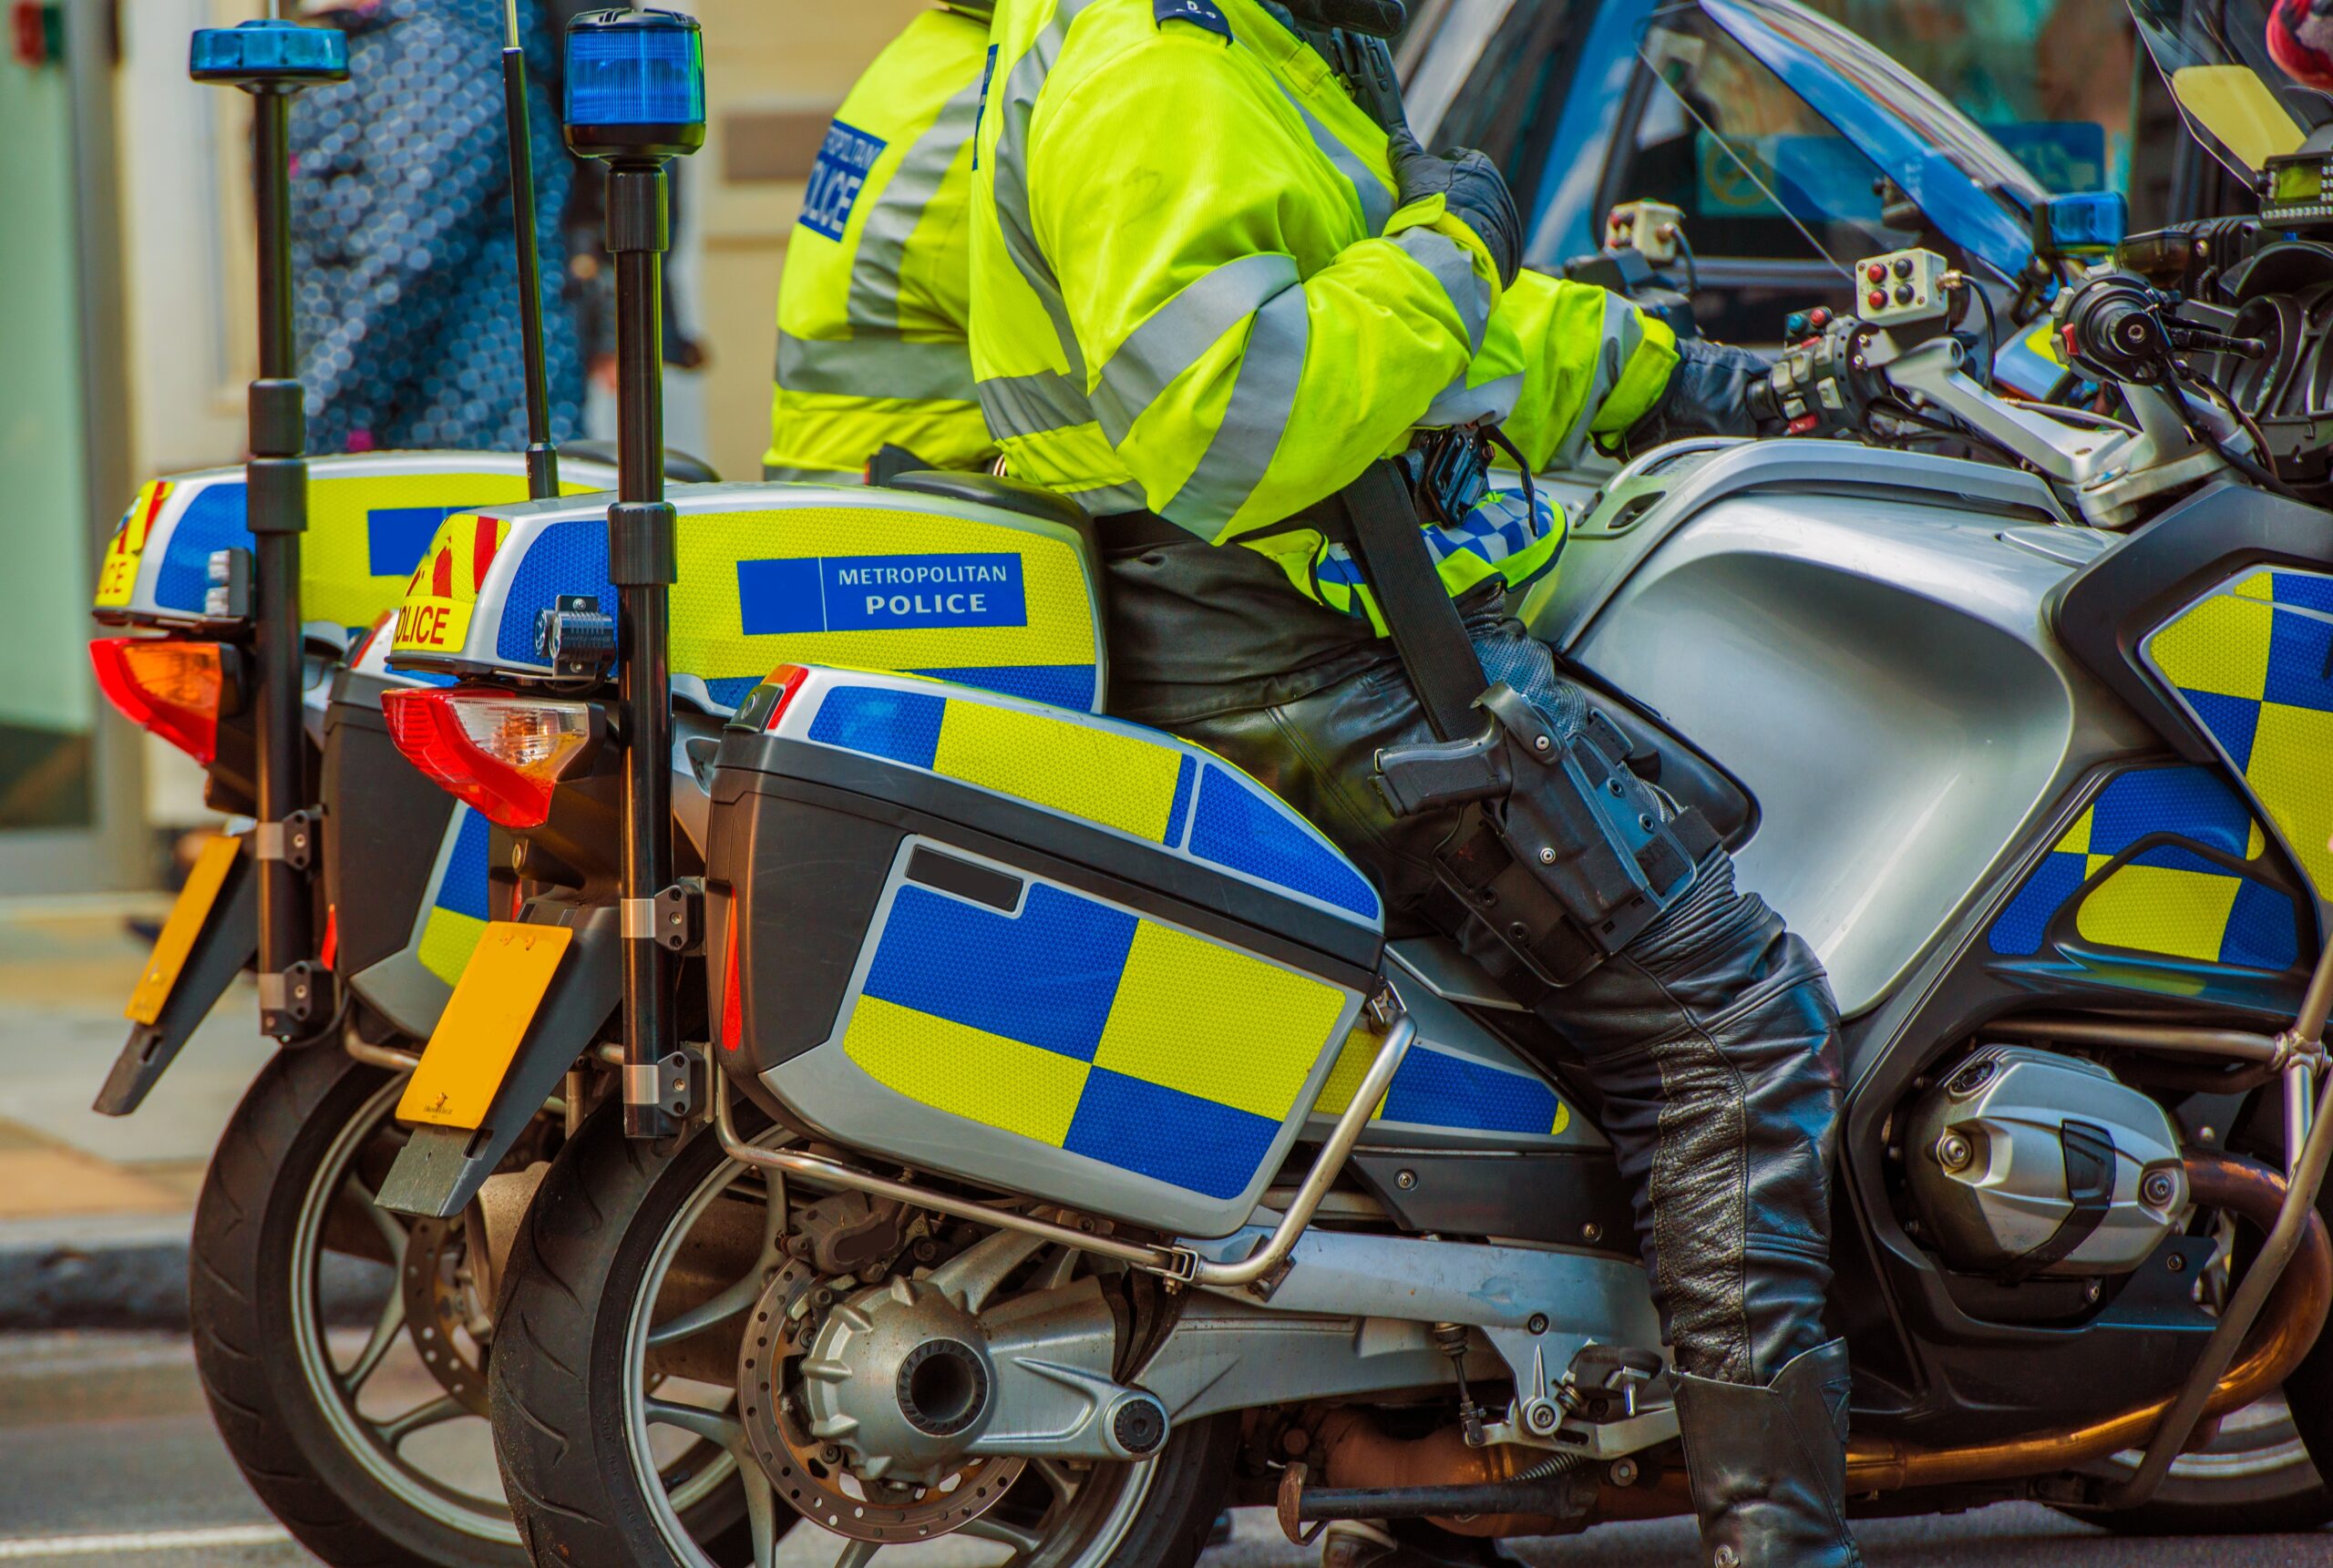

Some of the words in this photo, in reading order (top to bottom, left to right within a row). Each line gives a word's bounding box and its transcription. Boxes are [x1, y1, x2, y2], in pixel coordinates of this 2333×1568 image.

[803, 159, 863, 233] OLICE
[838, 565, 1008, 586] METROPOLITAN
[866, 593, 988, 616] POLICE
[395, 605, 451, 645] OLICE
